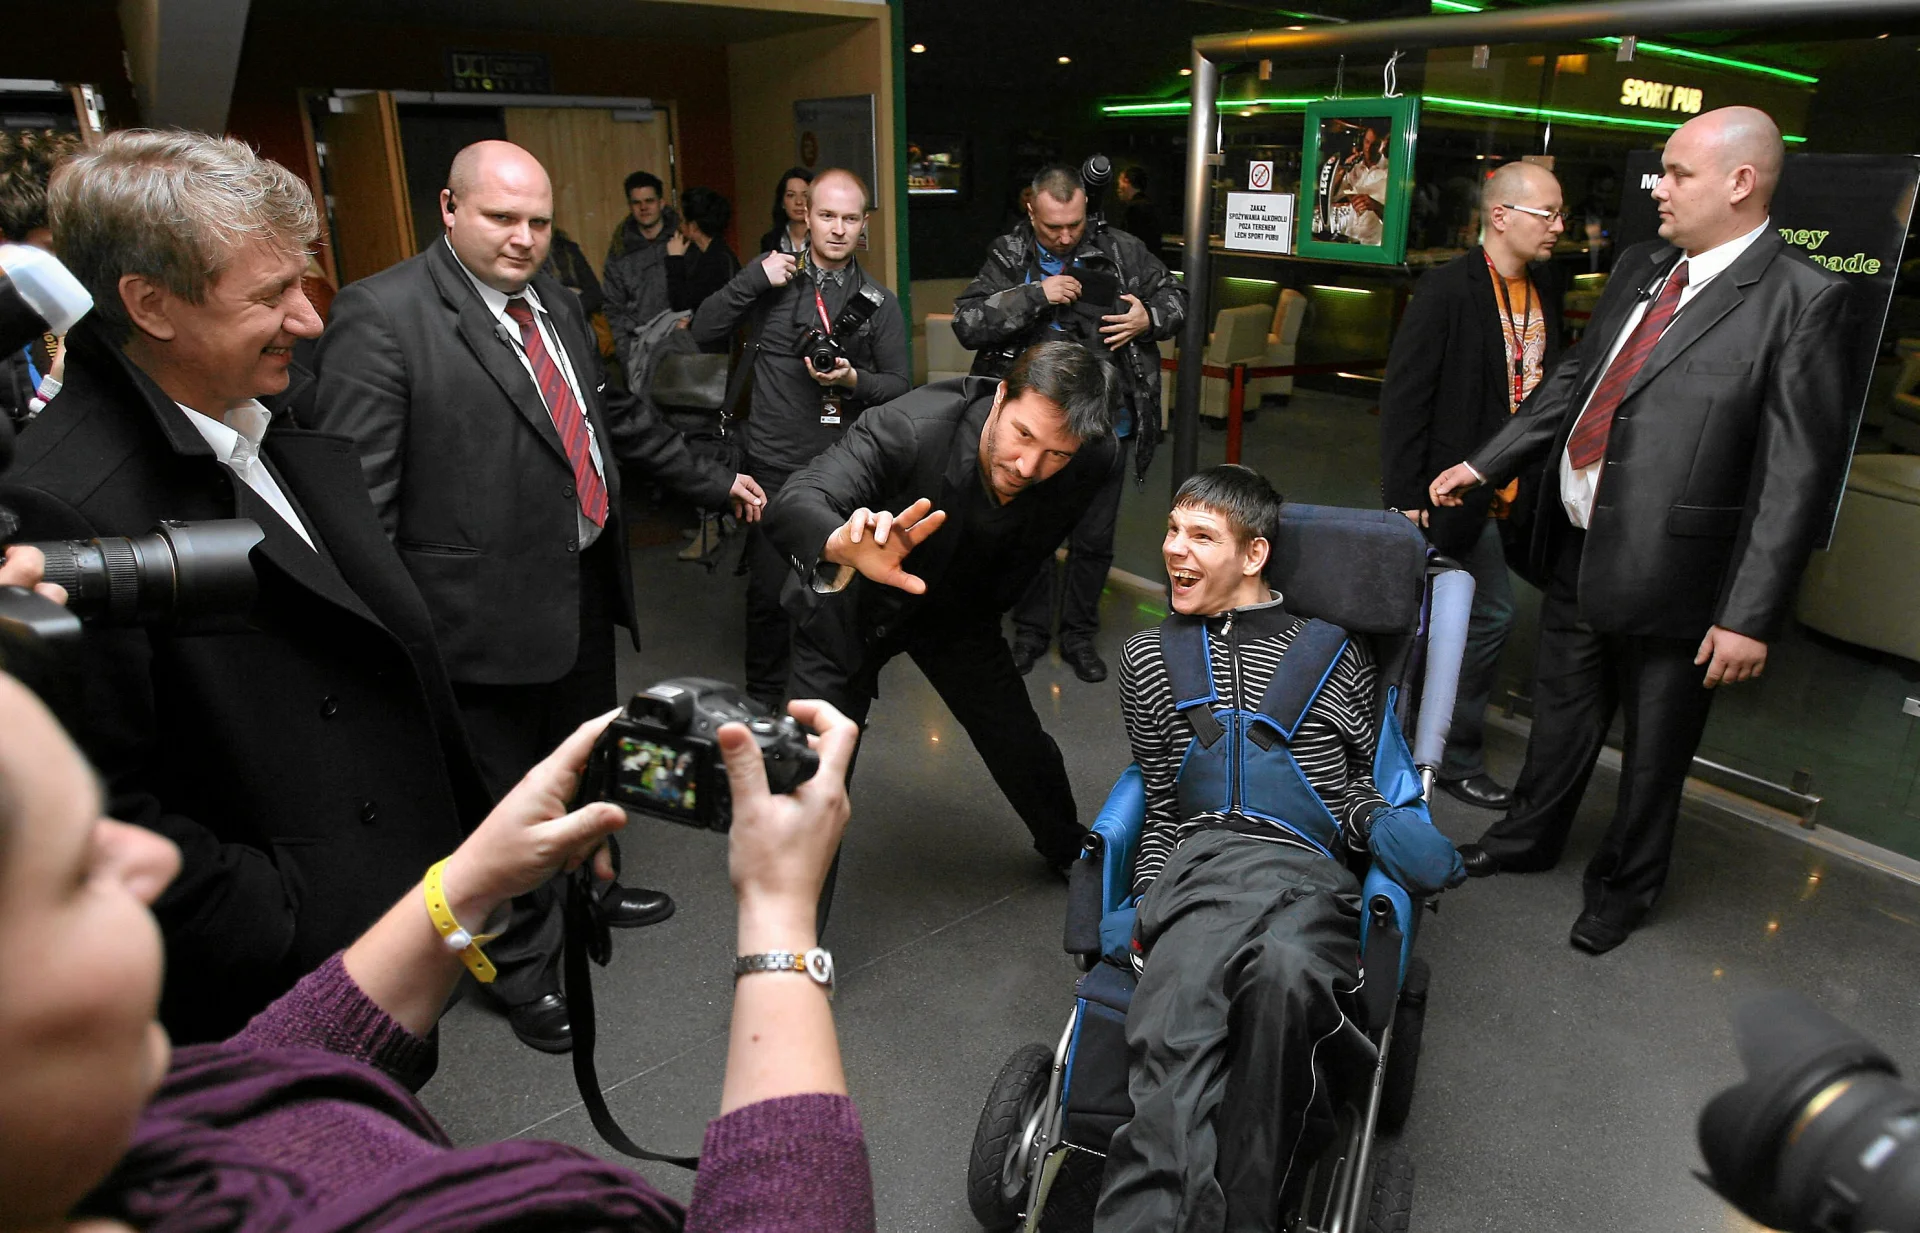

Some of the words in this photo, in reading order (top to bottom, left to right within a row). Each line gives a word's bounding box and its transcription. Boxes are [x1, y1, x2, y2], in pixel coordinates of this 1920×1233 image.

[1620, 78, 1673, 109] SPORT
[1671, 86, 1703, 113] PUB
[1320, 165, 1331, 195] LECH
[1261, 214, 1287, 222] ALKOHOLU
[1252, 223, 1276, 231] TERENEM
[1234, 231, 1247, 239] LECH
[1247, 232, 1264, 240] SPORT
[1265, 233, 1279, 241] PUBU
